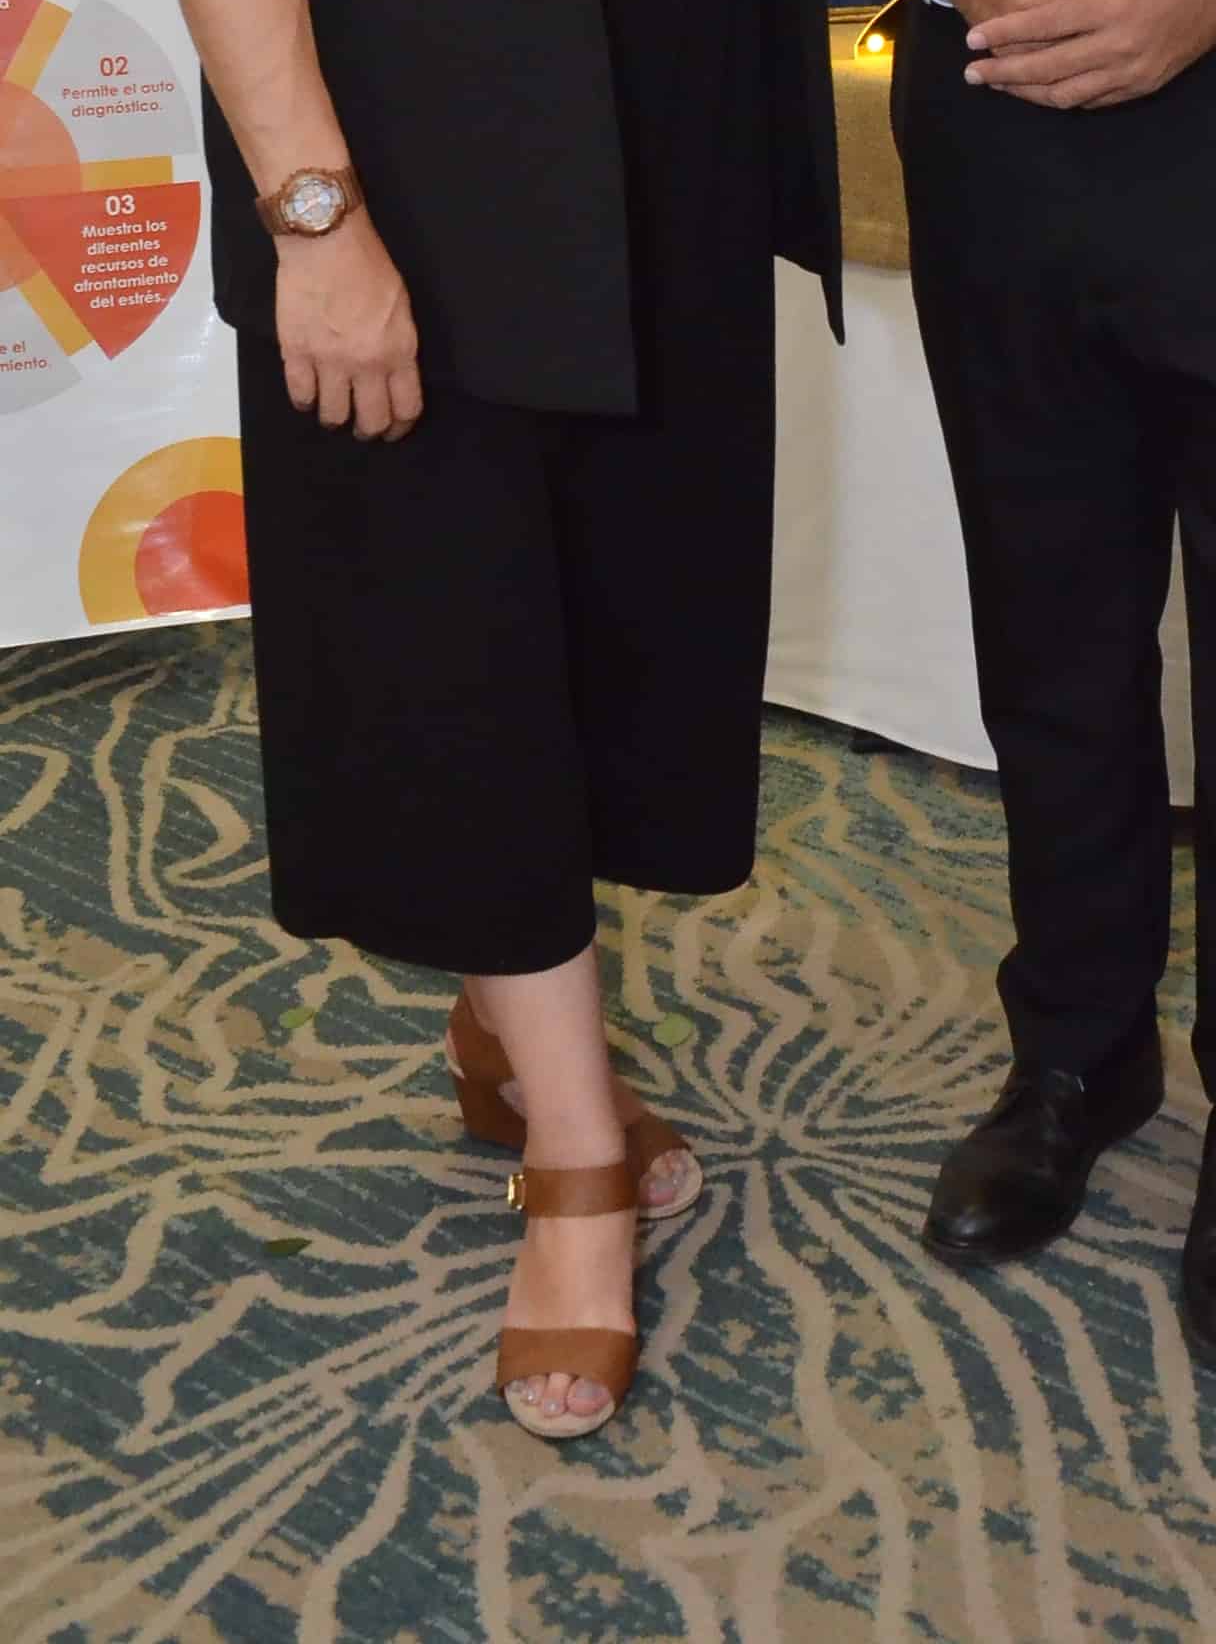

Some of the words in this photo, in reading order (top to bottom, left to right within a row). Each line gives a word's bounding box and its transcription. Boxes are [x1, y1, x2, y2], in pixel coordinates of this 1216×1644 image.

[99, 56, 129, 77] 02
[62, 85, 118, 99] Permite
[123, 83, 137, 96] el
[141, 81, 175, 94] auto
[71, 100, 163, 118] diagnóstico.
[105, 194, 136, 216] 03
[82, 222, 143, 238] Muestra
[146, 220, 168, 232] los
[87, 239, 161, 255] diferentes
[81, 258, 144, 274] recursos
[148, 256, 169, 268] de
[73, 272, 179, 293] afrontamiento
[90, 296, 115, 309] del
